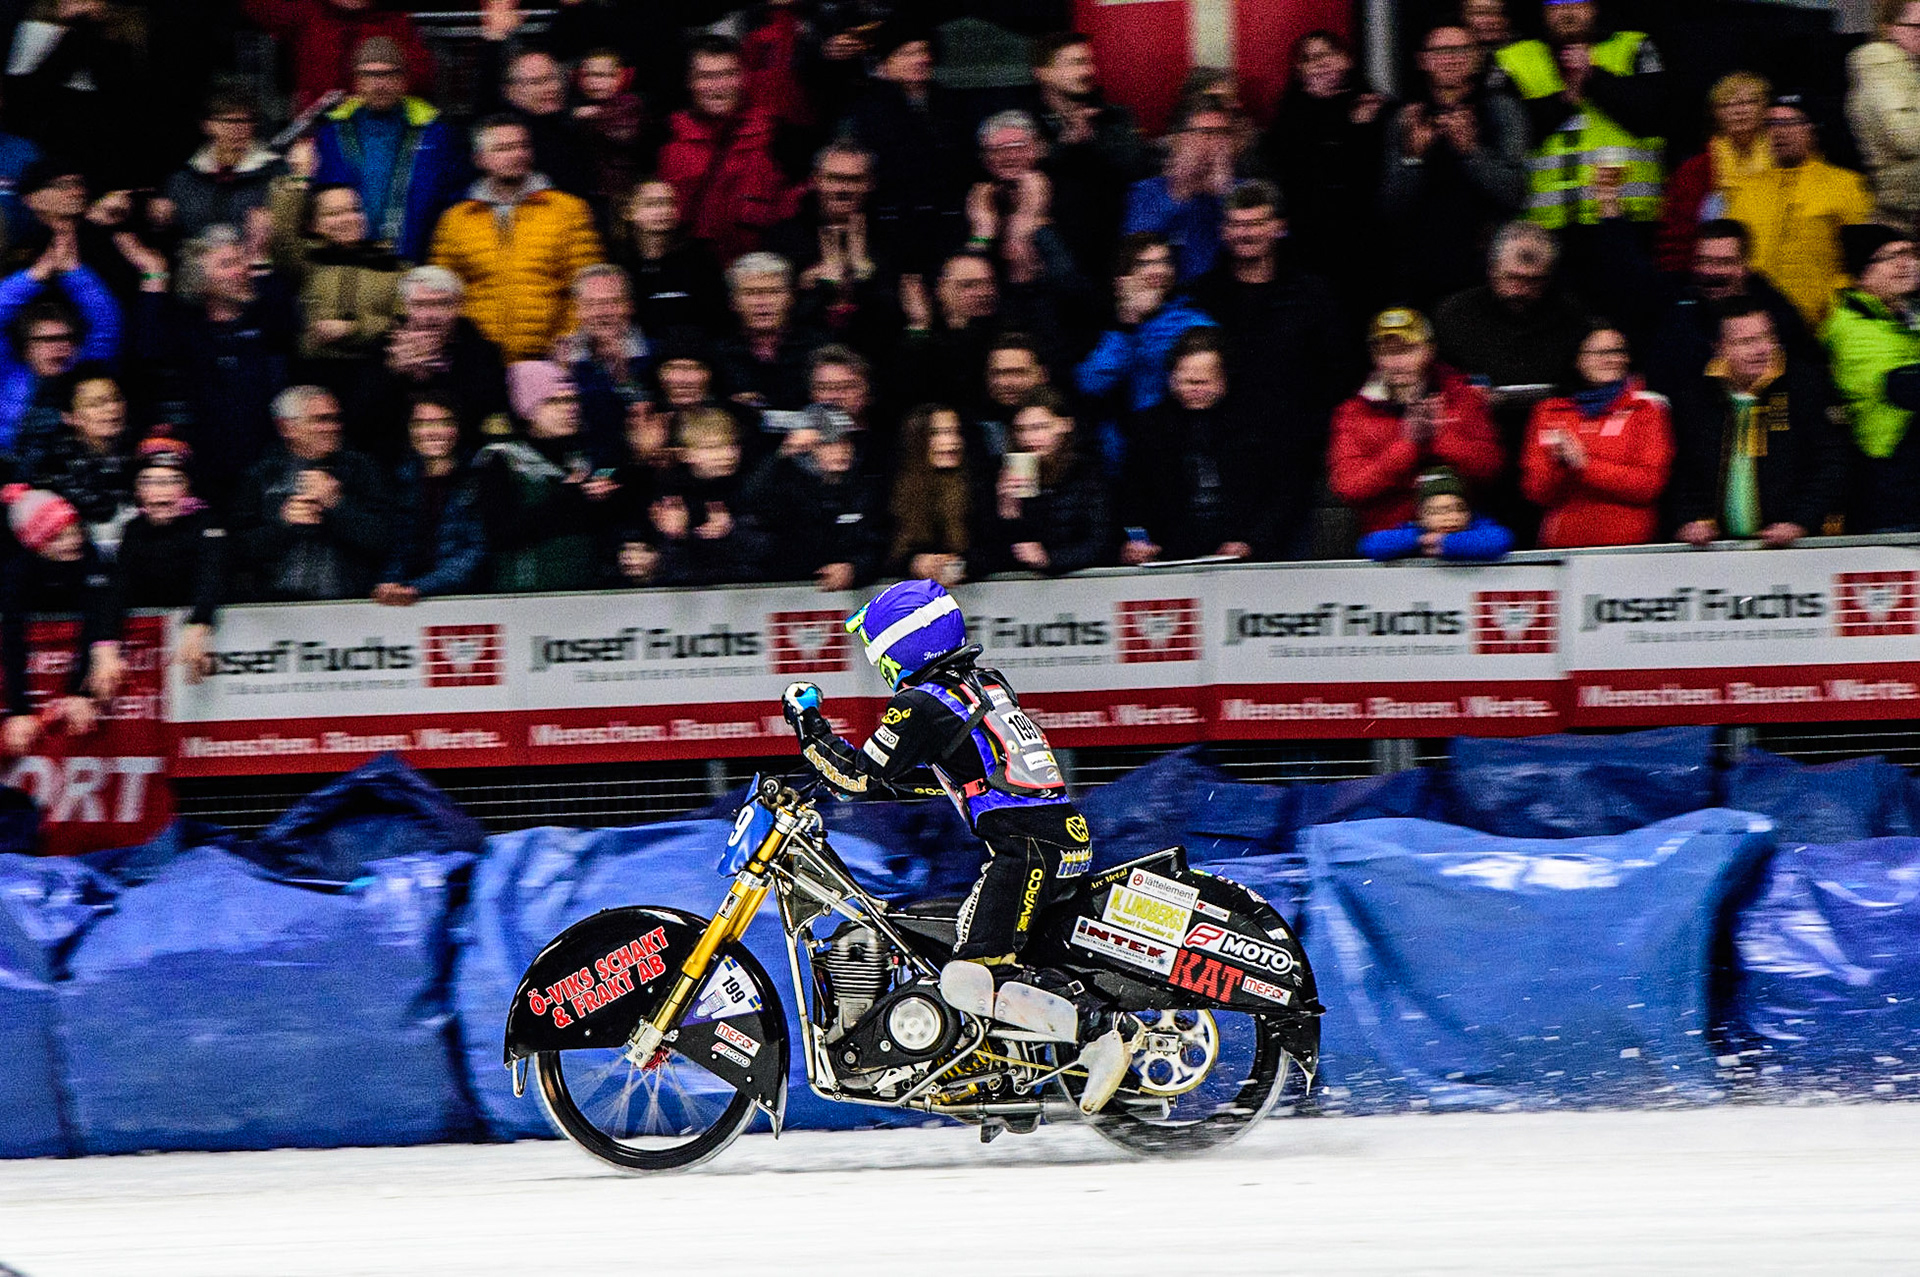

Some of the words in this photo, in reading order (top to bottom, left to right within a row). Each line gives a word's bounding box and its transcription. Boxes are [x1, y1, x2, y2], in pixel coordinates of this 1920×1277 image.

[1223, 602, 1338, 646] Josef
[1341, 600, 1466, 636] Fuchs
[1579, 587, 1697, 632] Josef
[1699, 583, 1826, 620] Fuchs
[529, 626, 642, 672] Josef
[645, 622, 765, 659] Fuchs
[989, 612, 1111, 648] Fuchs
[296, 636, 417, 673] Fuchs
[1008, 714, 1038, 741] 199
[1144, 876, 1194, 900] lättelement
[1123, 893, 1187, 932] LINDBERGS
[527, 966, 595, 1016] Ö-VIKS
[595, 925, 669, 982] SCHAKT
[1223, 935, 1289, 970] MOTO
[552, 1006, 574, 1029] &
[570, 971, 635, 1019] FRAKT
[637, 954, 667, 985] AB
[722, 975, 746, 1004] 199
[1168, 949, 1244, 1003] KAT
[724, 1048, 750, 1067] MOTO
